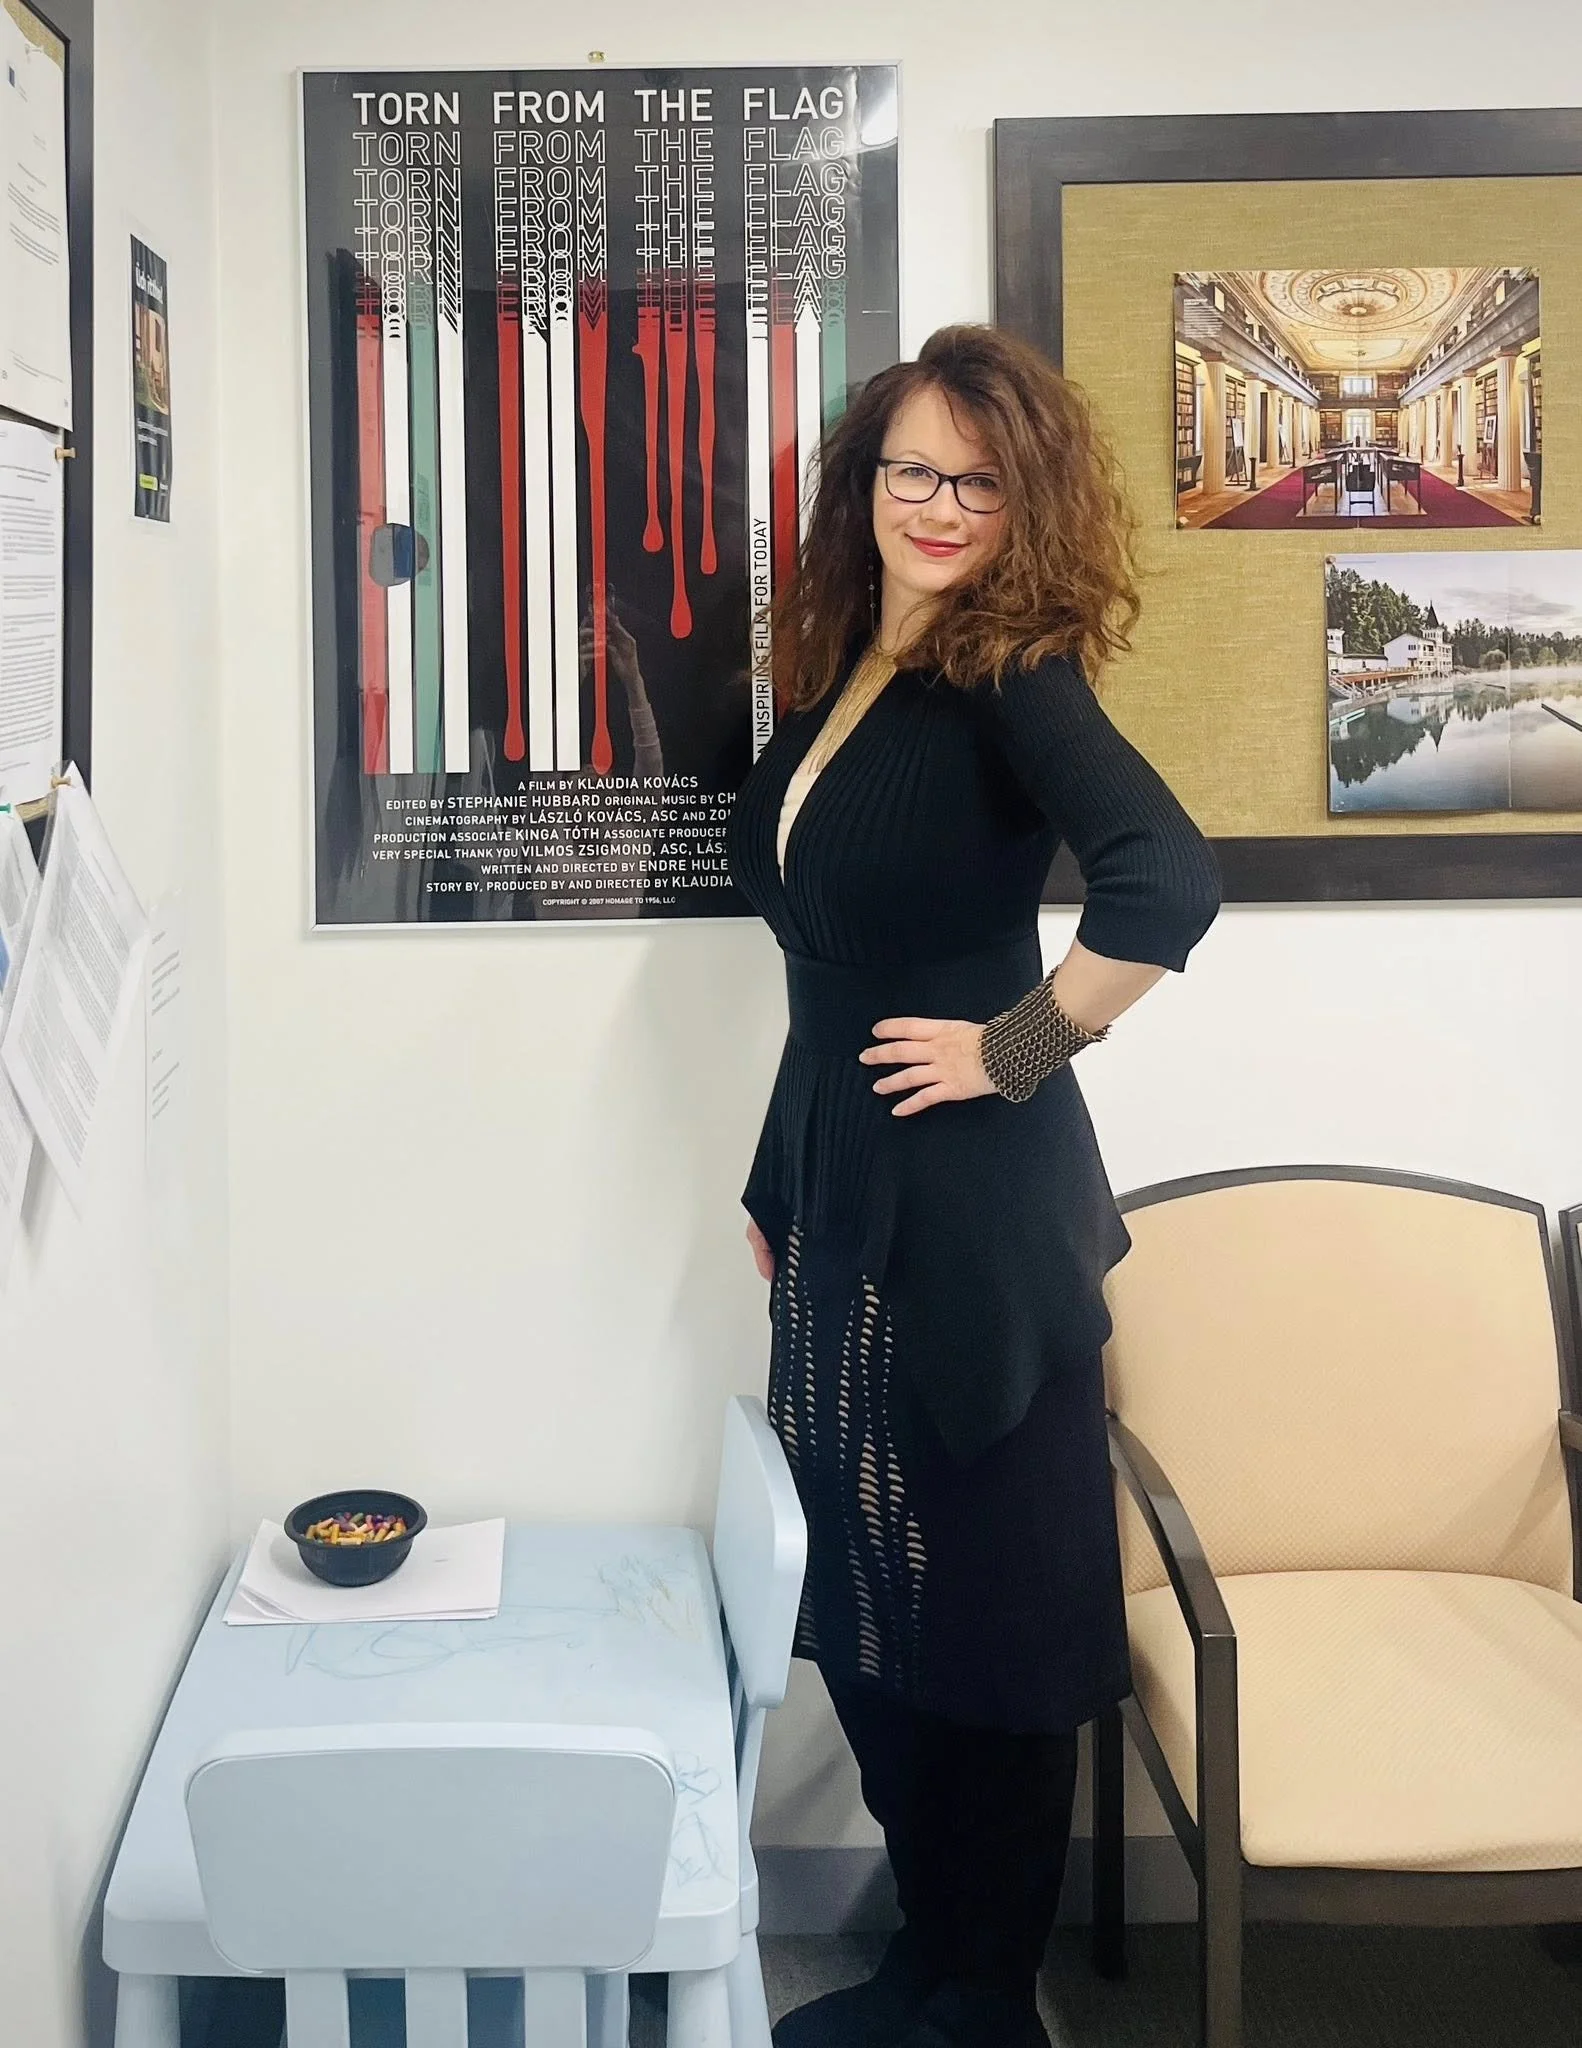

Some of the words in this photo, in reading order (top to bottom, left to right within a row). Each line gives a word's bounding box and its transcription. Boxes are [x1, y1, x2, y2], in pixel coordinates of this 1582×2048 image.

[353, 92, 460, 125] TORN
[493, 91, 605, 124] FROM
[634, 89, 712, 122] THE
[743, 87, 844, 121] FLAG
[353, 132, 460, 166] TORN
[494, 130, 605, 164] FROM
[634, 128, 713, 162] THE
[744, 127, 844, 161] FLAG
[354, 168, 461, 201] TORN
[494, 166, 605, 200] FROM
[635, 164, 714, 198] THE
[744, 163, 845, 197] FLAG
[754, 519, 767, 570] TODAY
[754, 574, 768, 606] FOR
[754, 612, 770, 648] FILM
[756, 656, 770, 736] INSPIRING
[518, 782, 525, 790] A
[529, 781, 555, 790] FILM
[560, 781, 573, 790] BY
[578, 778, 638, 789] KLAUDIA
[644, 774, 697, 788] KOVÁCS
[386, 800, 426, 809] EDITED
[431, 800, 444, 808] BY
[448, 796, 527, 808] STEPHANIE
[533, 795, 600, 806] HUBBARD
[605, 796, 657, 805] ORIGINAL
[662, 795, 696, 804] MUSIC
[701, 795, 713, 804] BY
[718, 793, 735, 803] CH
[405, 815, 508, 826] CINEMATOGRAPHY
[512, 815, 526, 824] BY
[530, 809, 581, 823] LÁSZLÓ
[588, 808, 646, 823] KOVÁCS,
[651, 810, 677, 821] ASC
[683, 812, 705, 820] AND
[374, 833, 446, 843] PRODUCTION
[450, 832, 511, 841] ASSOCIATE
[516, 829, 559, 840] KINGA
[563, 825, 599, 839] TÓTH
[604, 829, 665, 839] ASSOCIATE
[373, 851, 400, 859] VERY
[404, 850, 451, 859] SPECIAL
[455, 849, 493, 858] THANK
[496, 848, 517, 857] YOU
[522, 845, 573, 856] VILMOS
[579, 844, 655, 856] ZSIGMOND,
[661, 843, 691, 855] ASC,
[481, 865, 531, 874] WRITTEN
[535, 864, 558, 873] AND
[563, 863, 617, 872] DIRECTED
[622, 863, 635, 871] BY
[639, 860, 686, 871] ENDRE
[692, 859, 728, 870] HULE
[427, 883, 461, 892] STORY
[466, 882, 482, 892] BY,
[487, 881, 547, 891] PRODUCED
[552, 880, 565, 889] BY
[569, 880, 591, 889] AND
[596, 879, 650, 888] DIRECTED
[655, 879, 668, 887] BY
[673, 876, 732, 887] KLAUDIA
